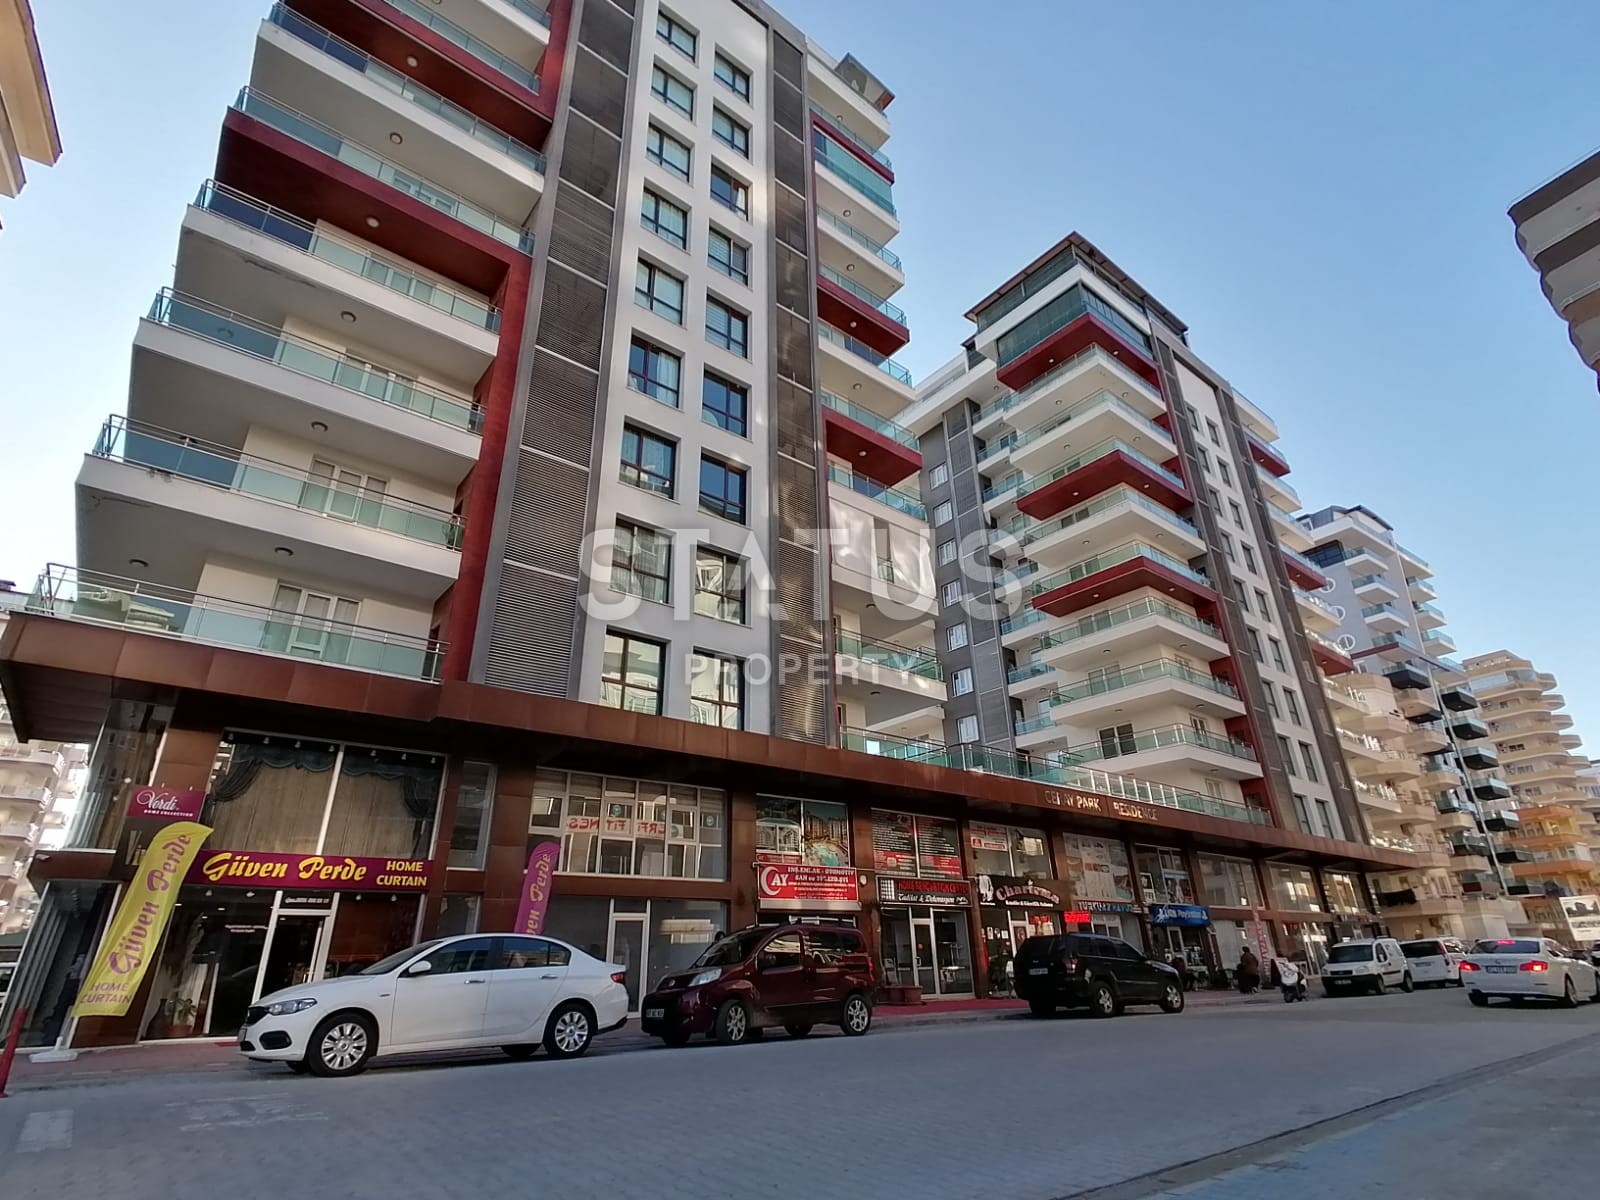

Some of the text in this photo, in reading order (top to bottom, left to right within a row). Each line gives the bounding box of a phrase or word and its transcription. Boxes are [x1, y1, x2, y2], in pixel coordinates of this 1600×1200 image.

[202, 852, 368, 882] Güven Perde
[385, 860, 424, 873] HOME
[375, 874, 428, 887] CURTAIN
[91, 982, 129, 992] HOME
